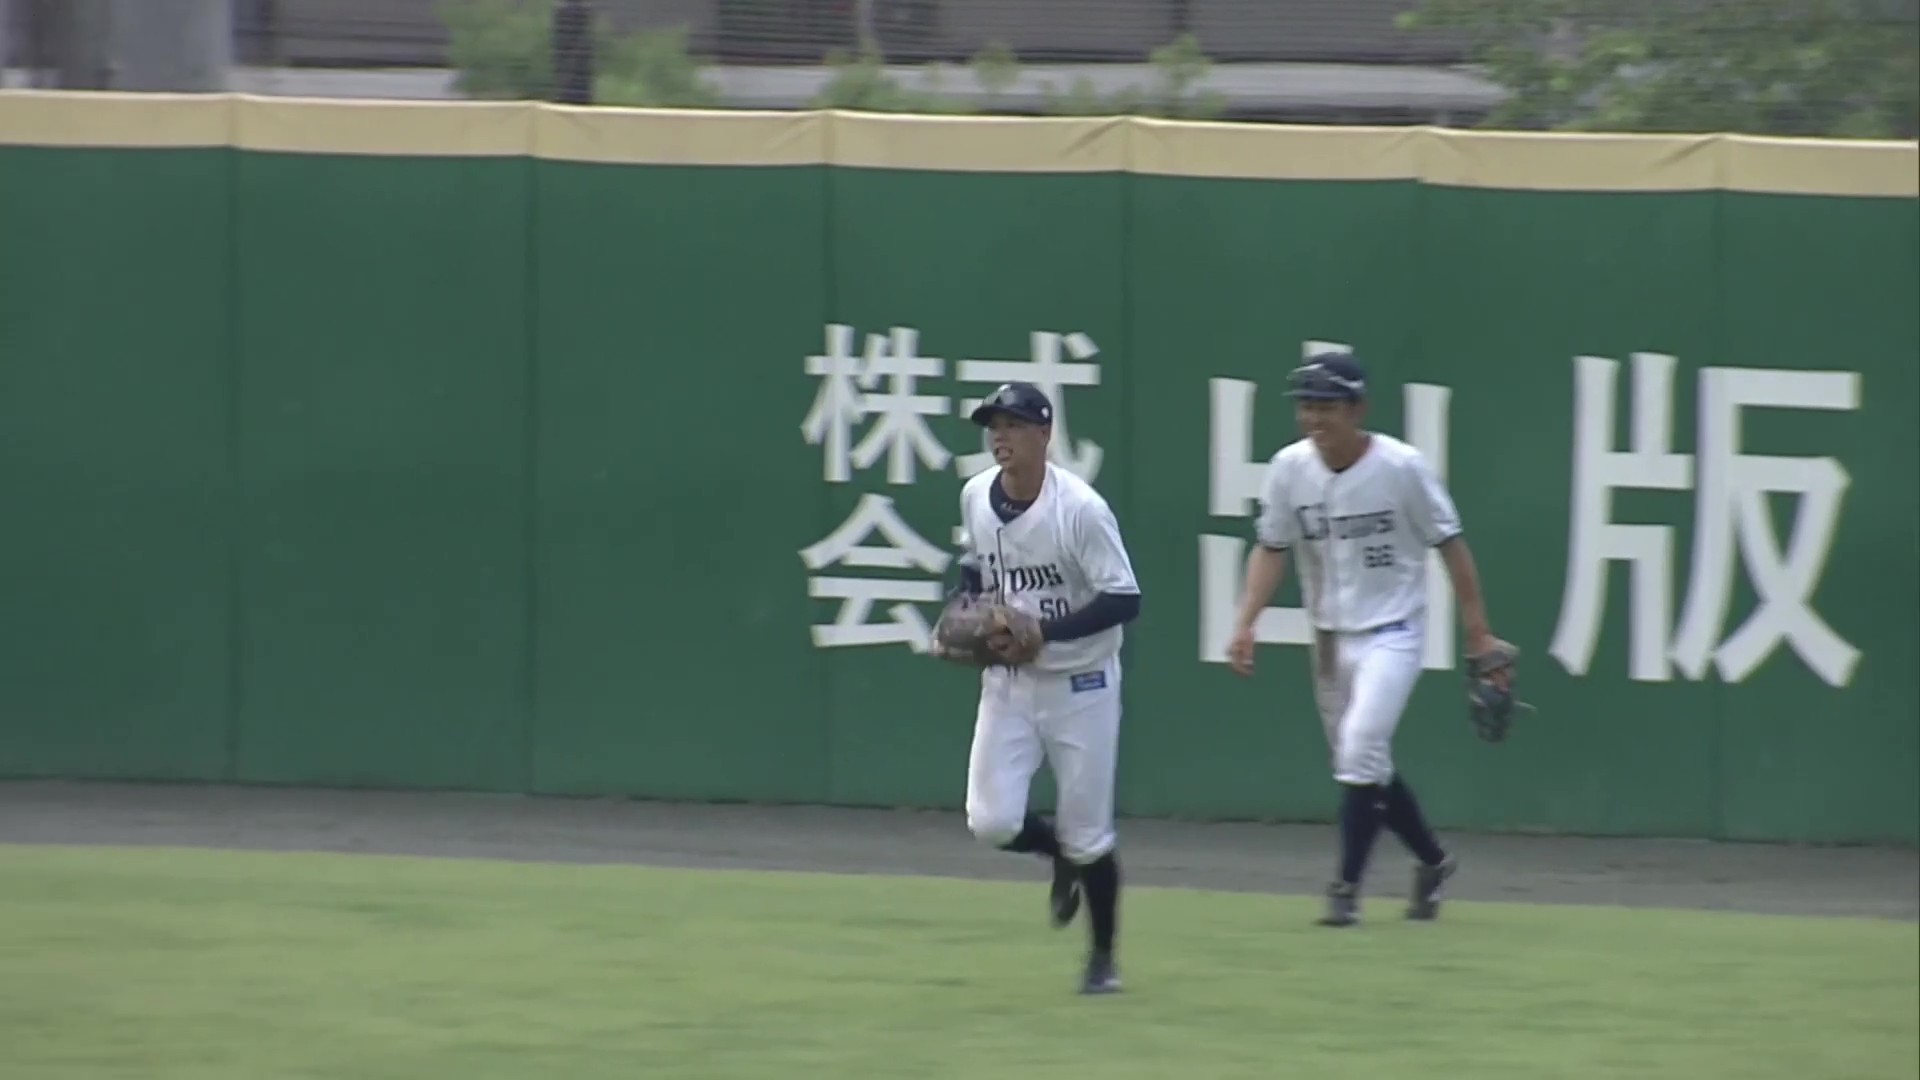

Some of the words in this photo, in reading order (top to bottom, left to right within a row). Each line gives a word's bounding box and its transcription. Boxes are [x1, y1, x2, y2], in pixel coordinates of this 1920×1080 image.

[800, 323, 1104, 485] 株式
[798, 492, 972, 655] 会
[1039, 597, 1071, 621] 50
